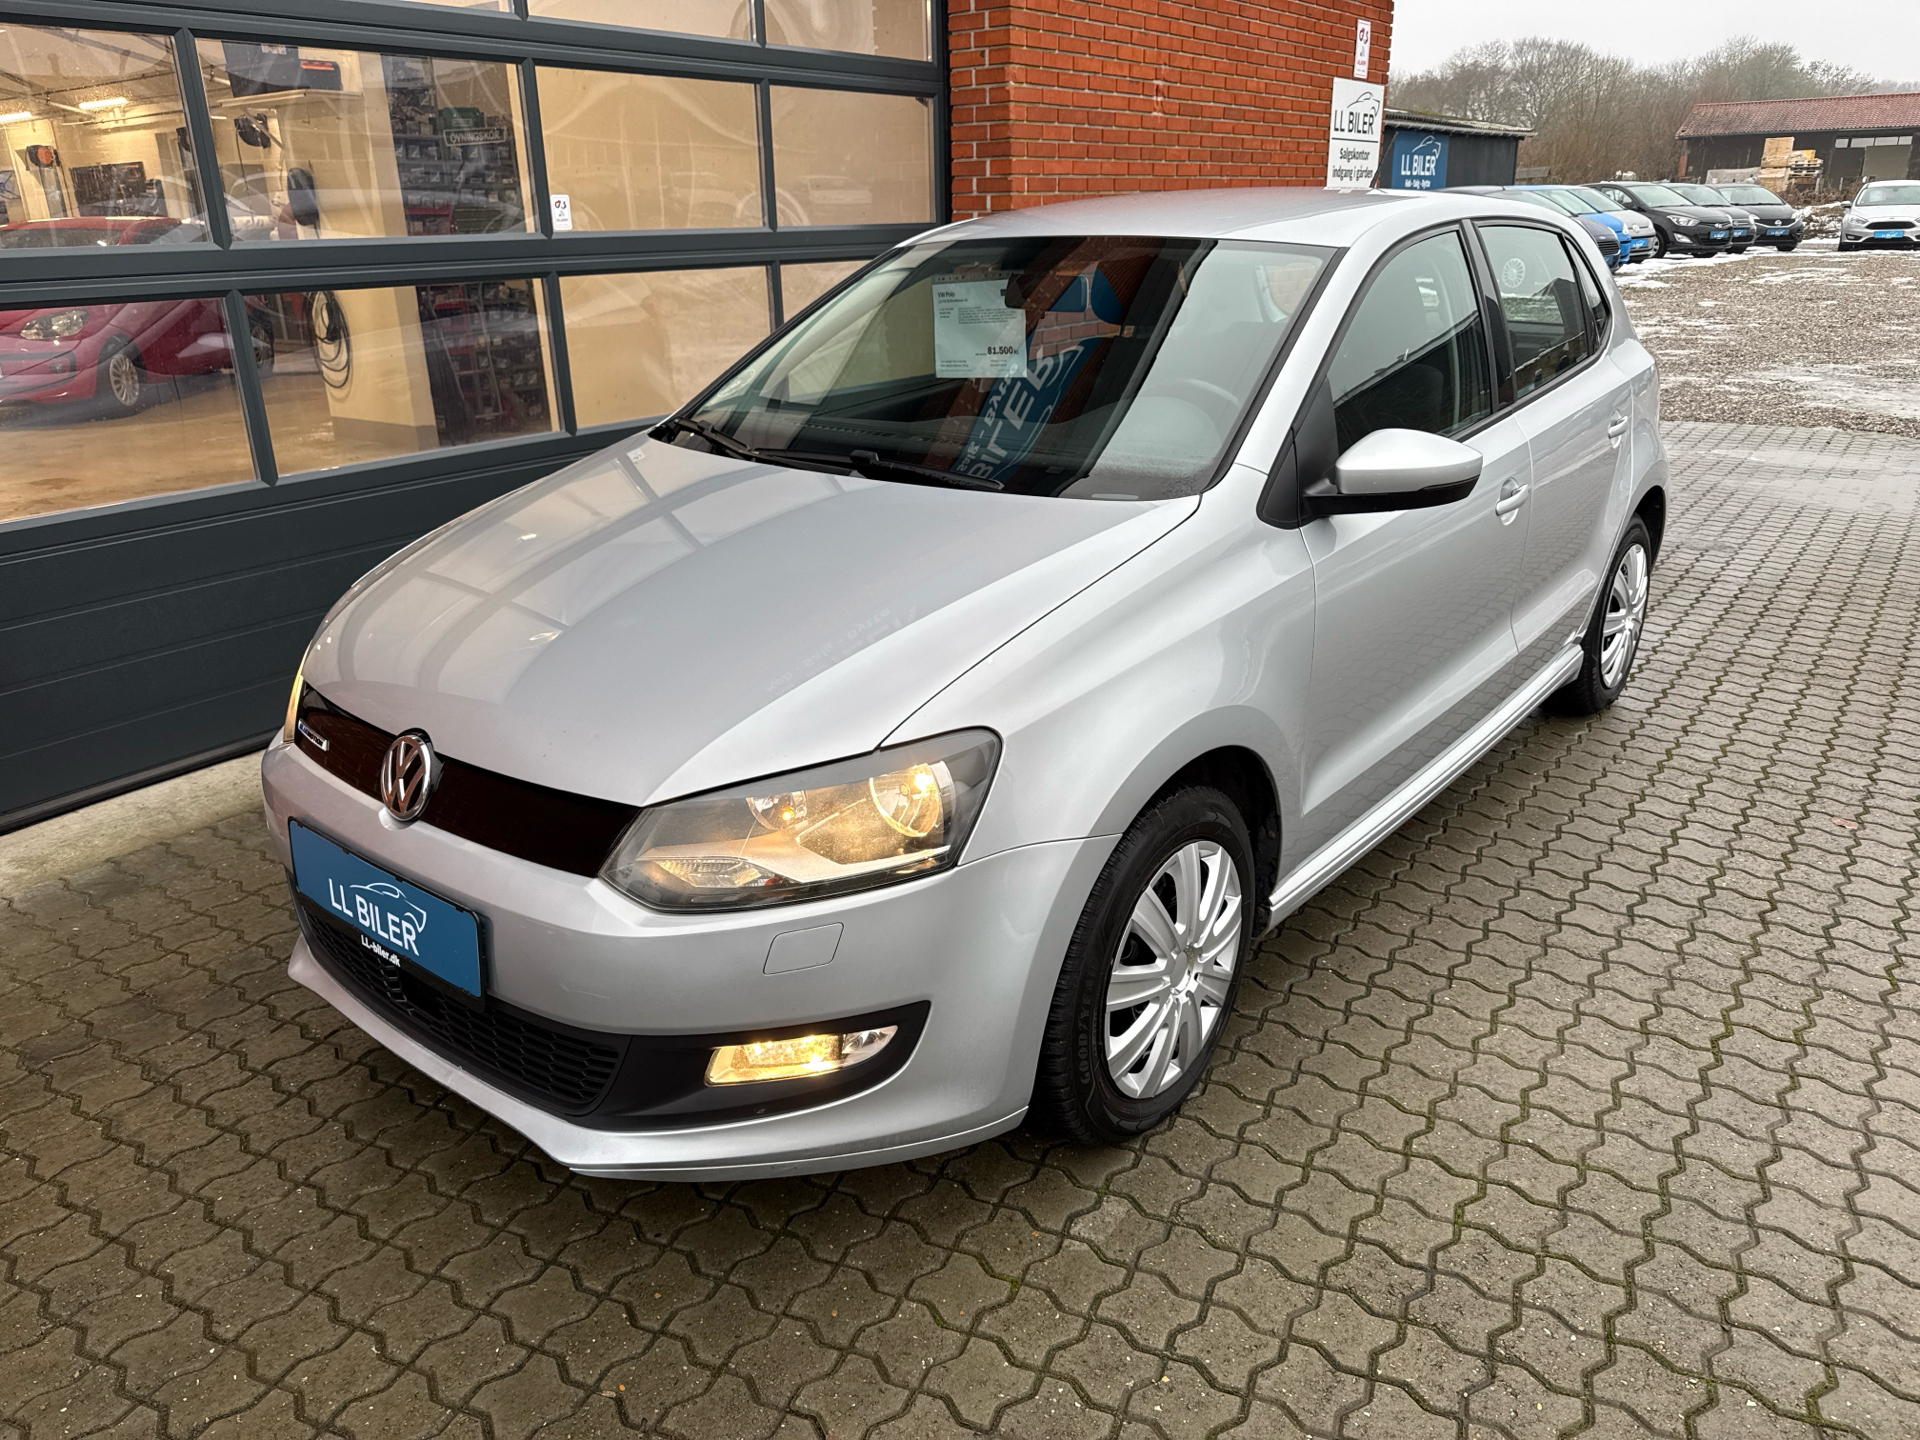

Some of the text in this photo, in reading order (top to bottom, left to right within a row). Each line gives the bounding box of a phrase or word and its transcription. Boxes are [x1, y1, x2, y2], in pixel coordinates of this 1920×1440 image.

[1333, 110, 1375, 135] LL BILER
[1340, 148, 1370, 163] Salgskontor
[1400, 154, 1436, 176] LL BILER
[1332, 166, 1353, 181] indgang
[1356, 166, 1374, 181] gården
[987, 346, 1013, 355] 81.500
[328, 877, 420, 957] LL BILER
[360, 934, 401, 967] LL-biler.dk
